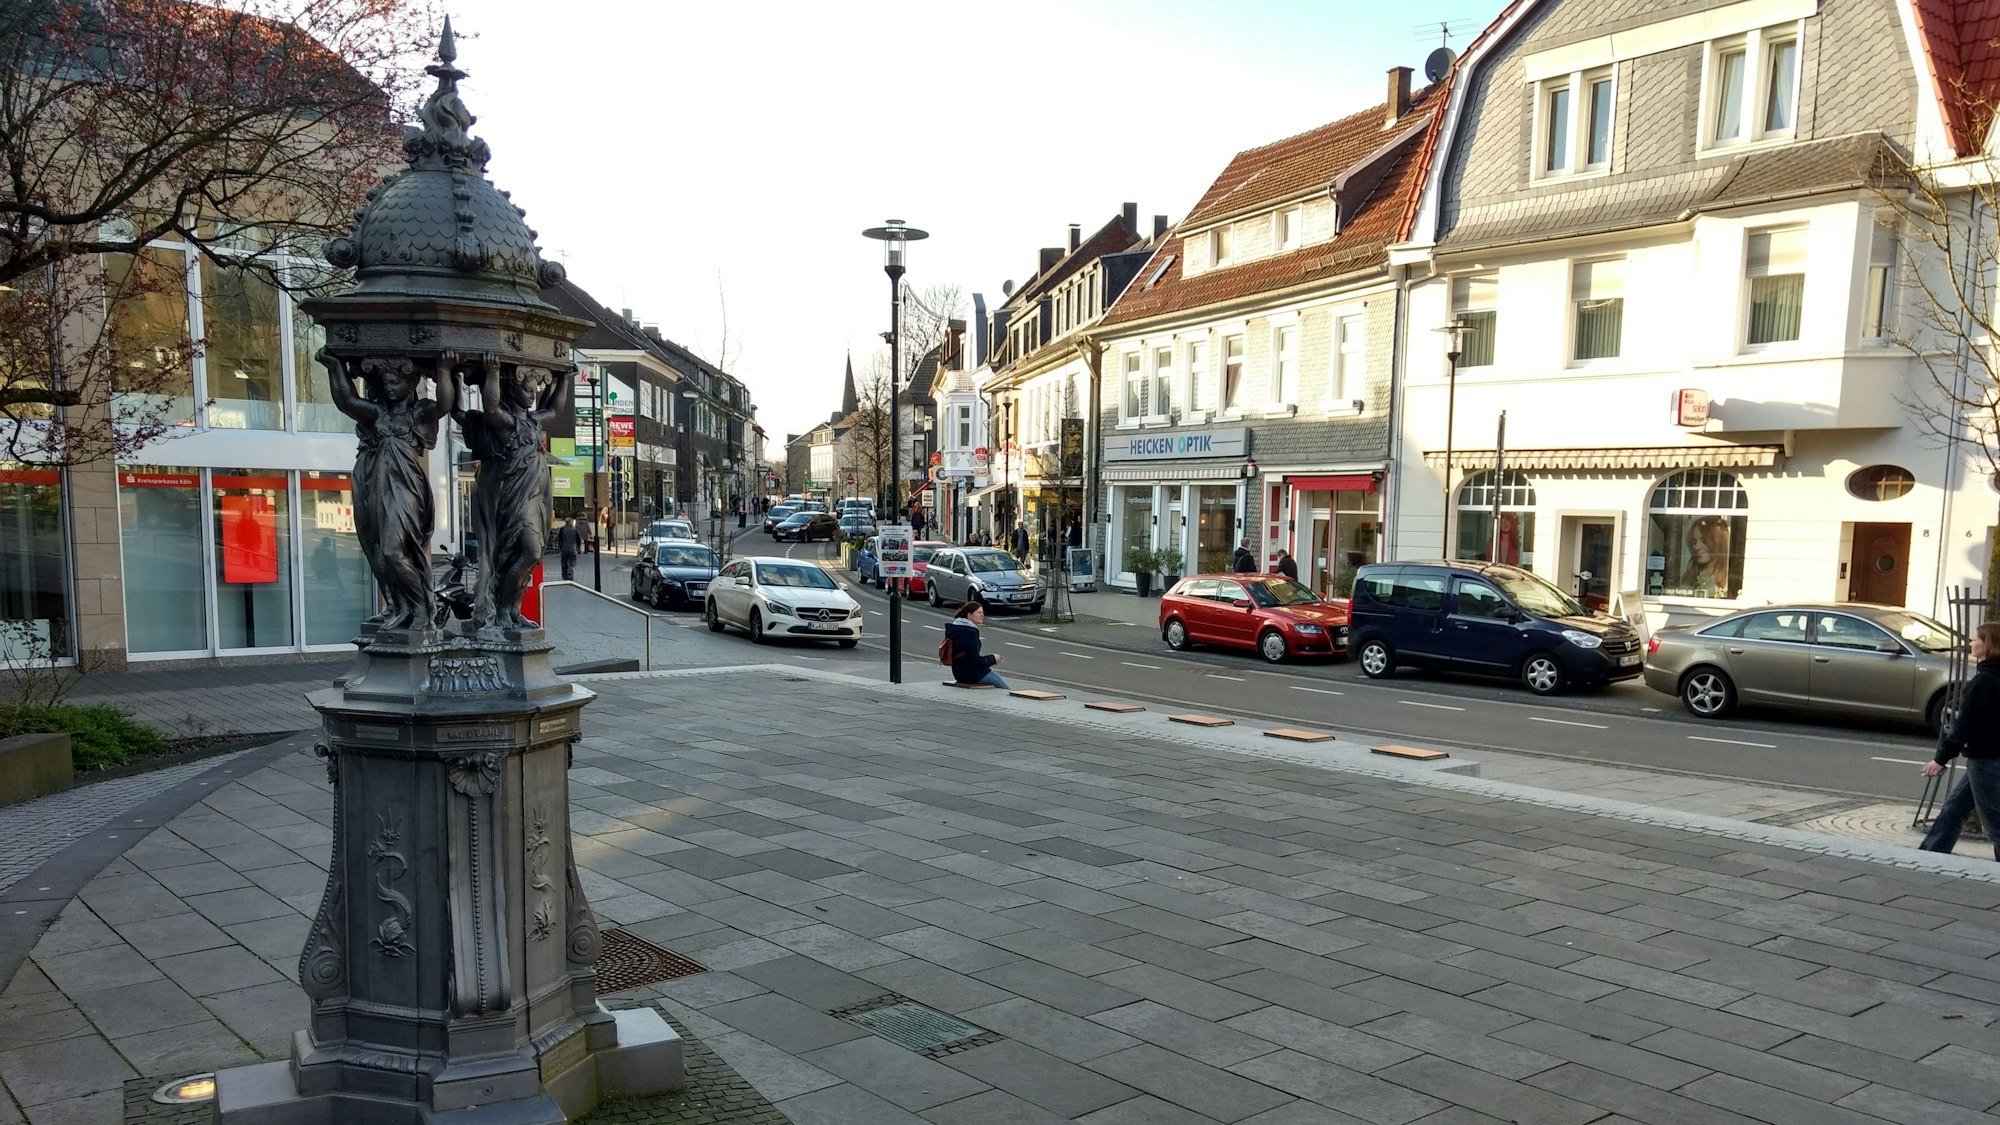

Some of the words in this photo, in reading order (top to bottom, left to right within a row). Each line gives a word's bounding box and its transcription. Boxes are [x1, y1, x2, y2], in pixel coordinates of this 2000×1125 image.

[609, 421, 634, 430] REWE
[1130, 438, 1173, 455] HEICKEN
[1178, 435, 1212, 453] OPTIK
[1922, 529, 1930, 537] 8
[1965, 530, 1973, 538] 6
[447, 730, 463, 739] VAL
